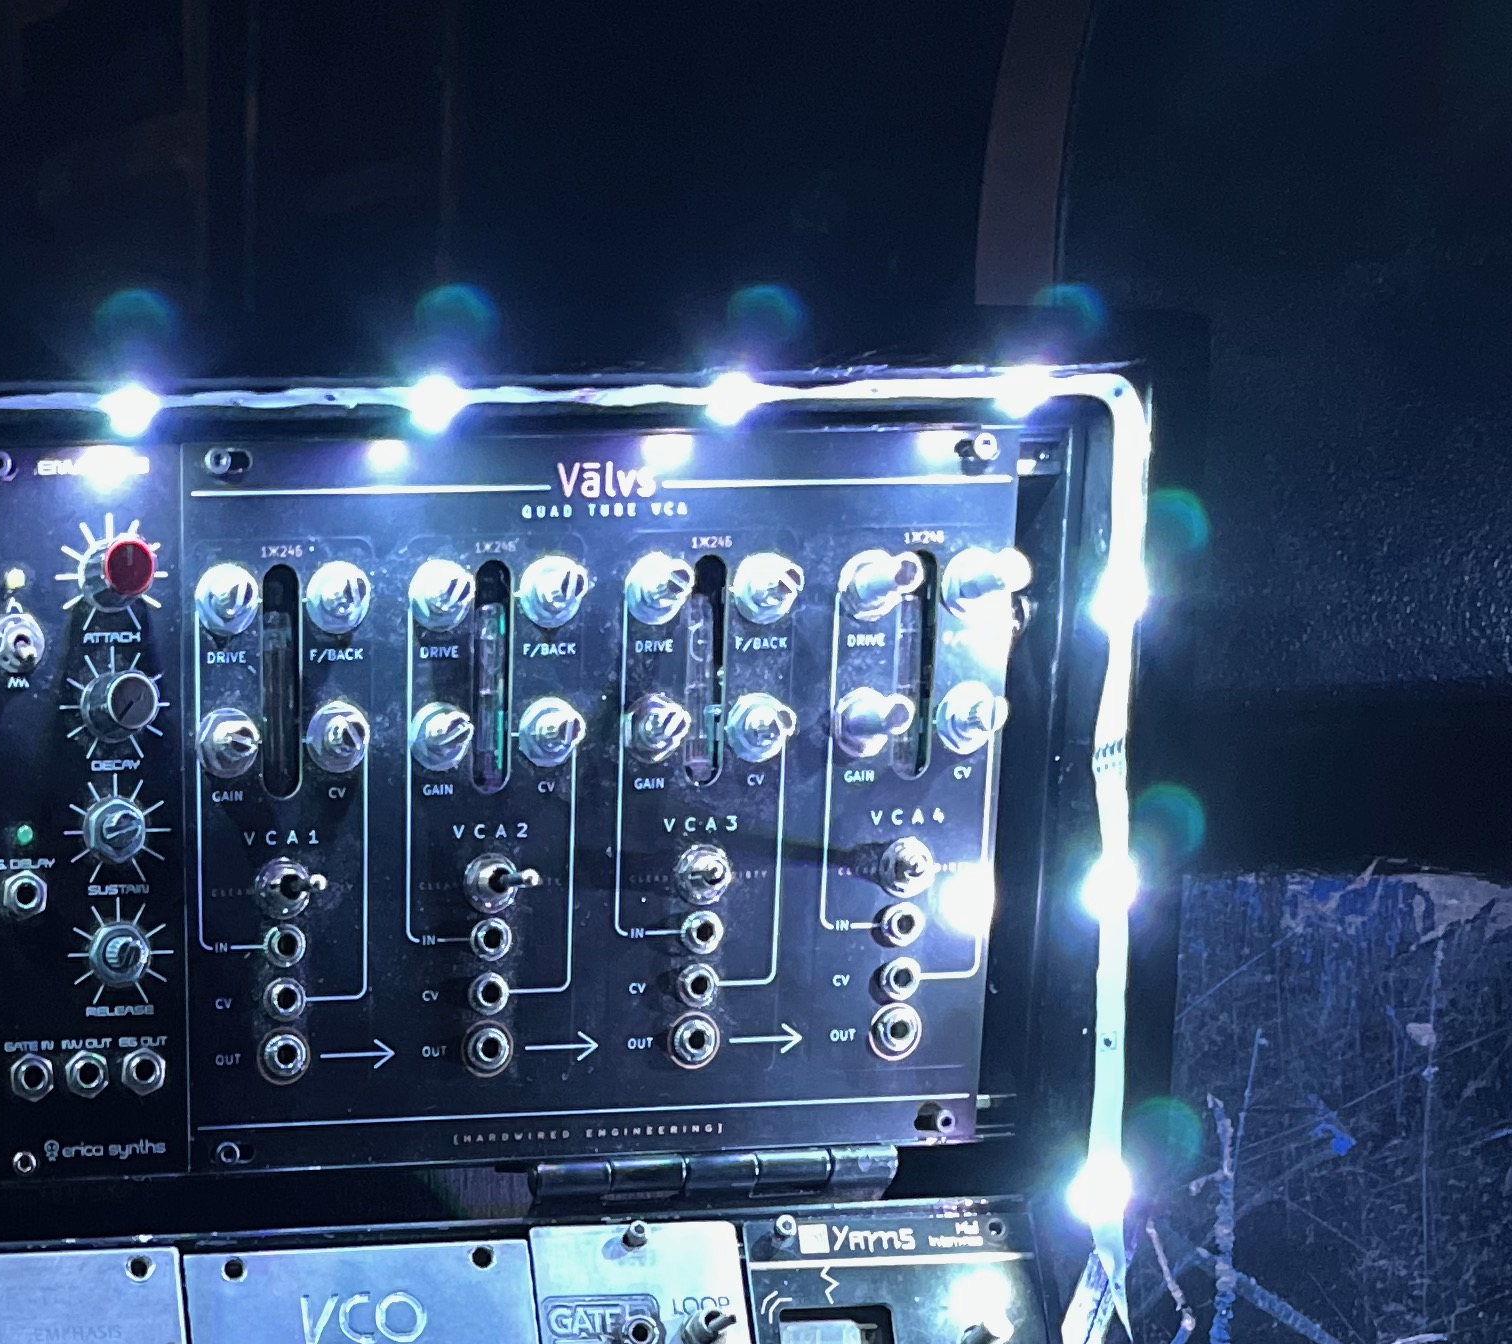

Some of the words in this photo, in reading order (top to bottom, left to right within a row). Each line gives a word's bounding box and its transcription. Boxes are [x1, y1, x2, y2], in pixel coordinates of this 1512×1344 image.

[522, 503, 572, 518] QUAD
[589, 503, 636, 517] TUBE
[652, 502, 688, 516] VCA
[83, 631, 141, 644] ATTACK
[735, 636, 788, 651] F/BACK
[847, 633, 885, 648] DRIVE
[420, 645, 459, 659] DRIVE
[523, 642, 576, 657] F/BACK
[635, 639, 673, 654] DRIVE
[207, 650, 247, 665] DRIVE
[310, 647, 364, 663] F/BACK
[91, 759, 141, 772] DECAY
[634, 777, 665, 790] GAIN
[844, 770, 875, 783] GAIN
[212, 789, 244, 803] GAIN
[329, 786, 346, 799] CV
[423, 784, 454, 796] GAIN
[88, 883, 150, 895] SUSTAIN
[86, 1003, 154, 1018] RELEASE
[830, 1028, 856, 1043] OUT
[215, 1053, 241, 1065] OUT
[62, 1141, 104, 1158] erica
[108, 1140, 166, 1161] synths
[551, 1307, 620, 1336] GATE
